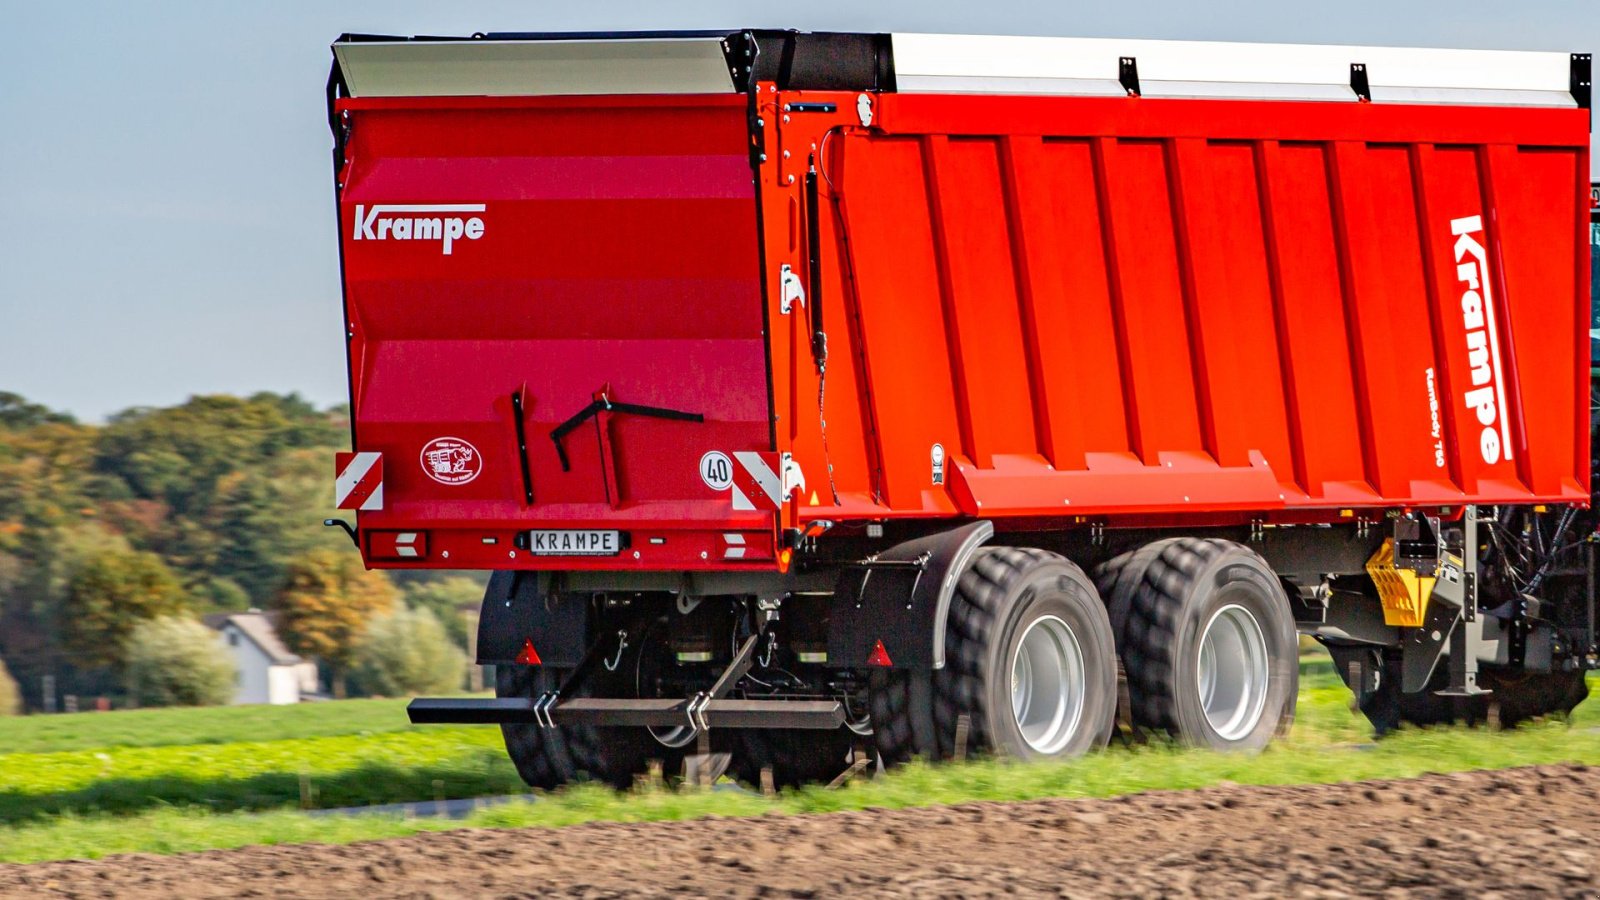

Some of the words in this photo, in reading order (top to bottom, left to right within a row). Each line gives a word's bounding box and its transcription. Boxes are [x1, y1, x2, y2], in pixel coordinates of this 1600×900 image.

[353, 204, 486, 255] Krampe
[1450, 215, 1513, 465] Krampe
[707, 458, 729, 482] 40
[535, 533, 612, 550] KRAMPE
